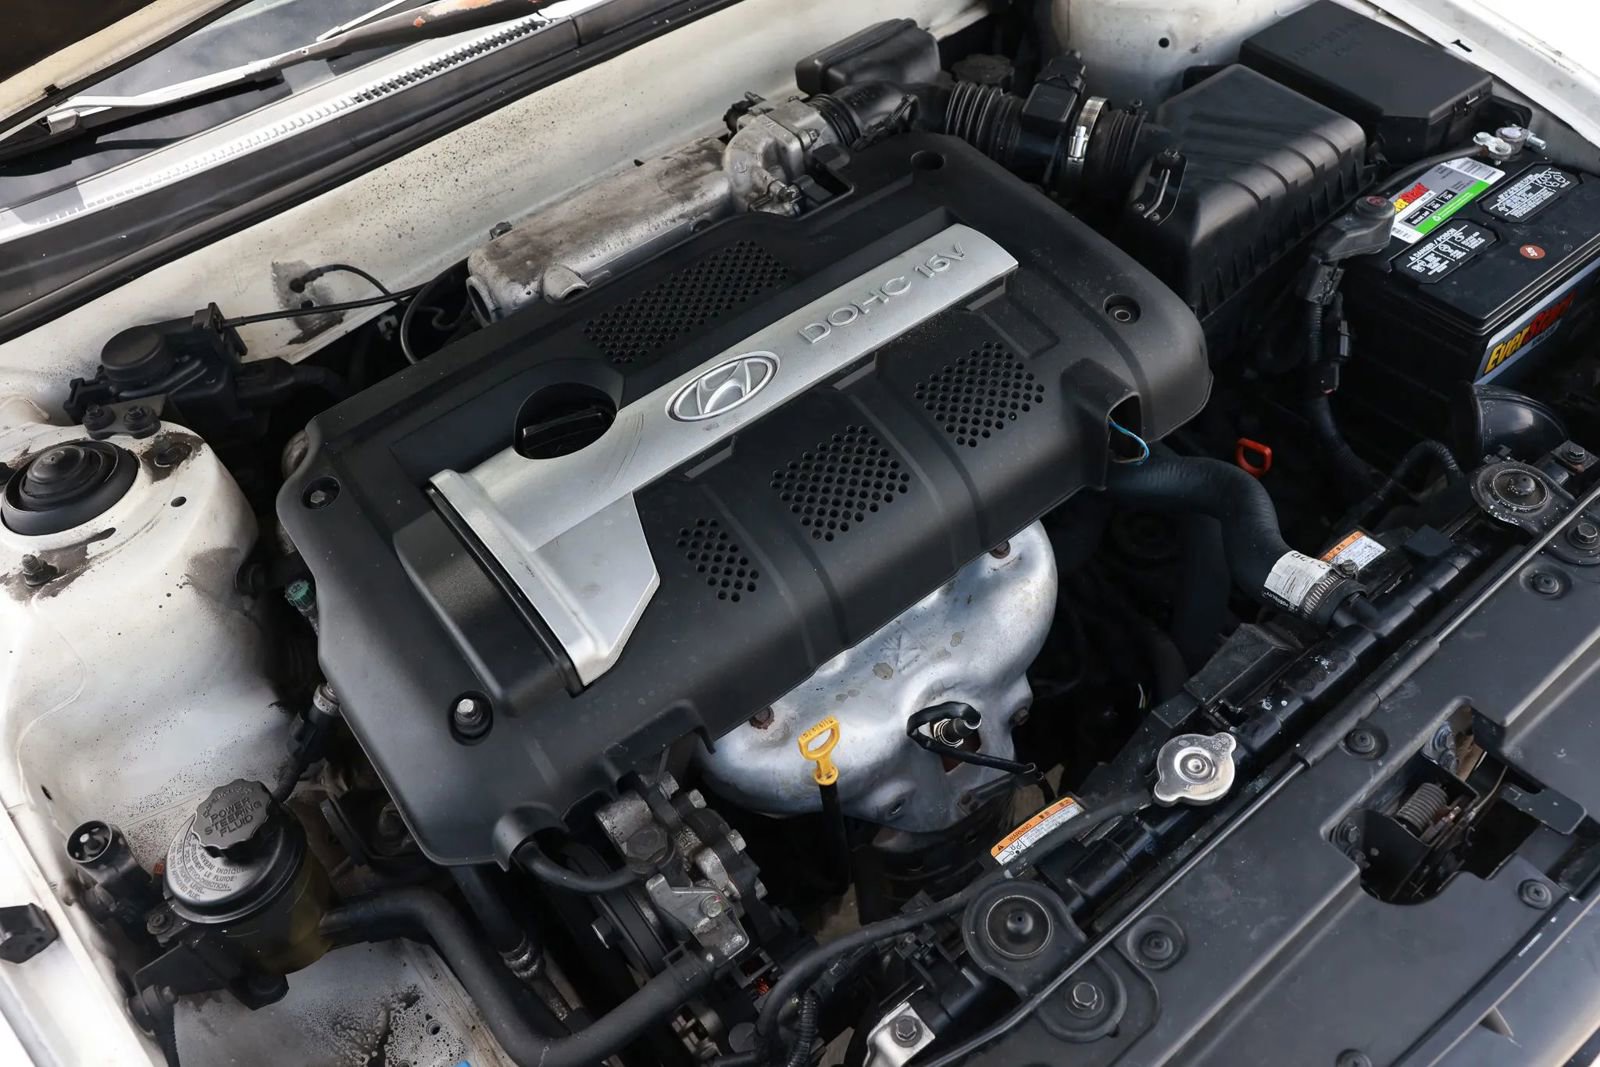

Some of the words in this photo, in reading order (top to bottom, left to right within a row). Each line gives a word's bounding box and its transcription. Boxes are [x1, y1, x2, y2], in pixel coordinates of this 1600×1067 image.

[798, 275, 912, 344] DOHC
[914, 241, 966, 278] 16V
[204, 800, 263, 836] STEERING
[210, 797, 251, 824] POWER
[220, 815, 254, 838] FLUID
